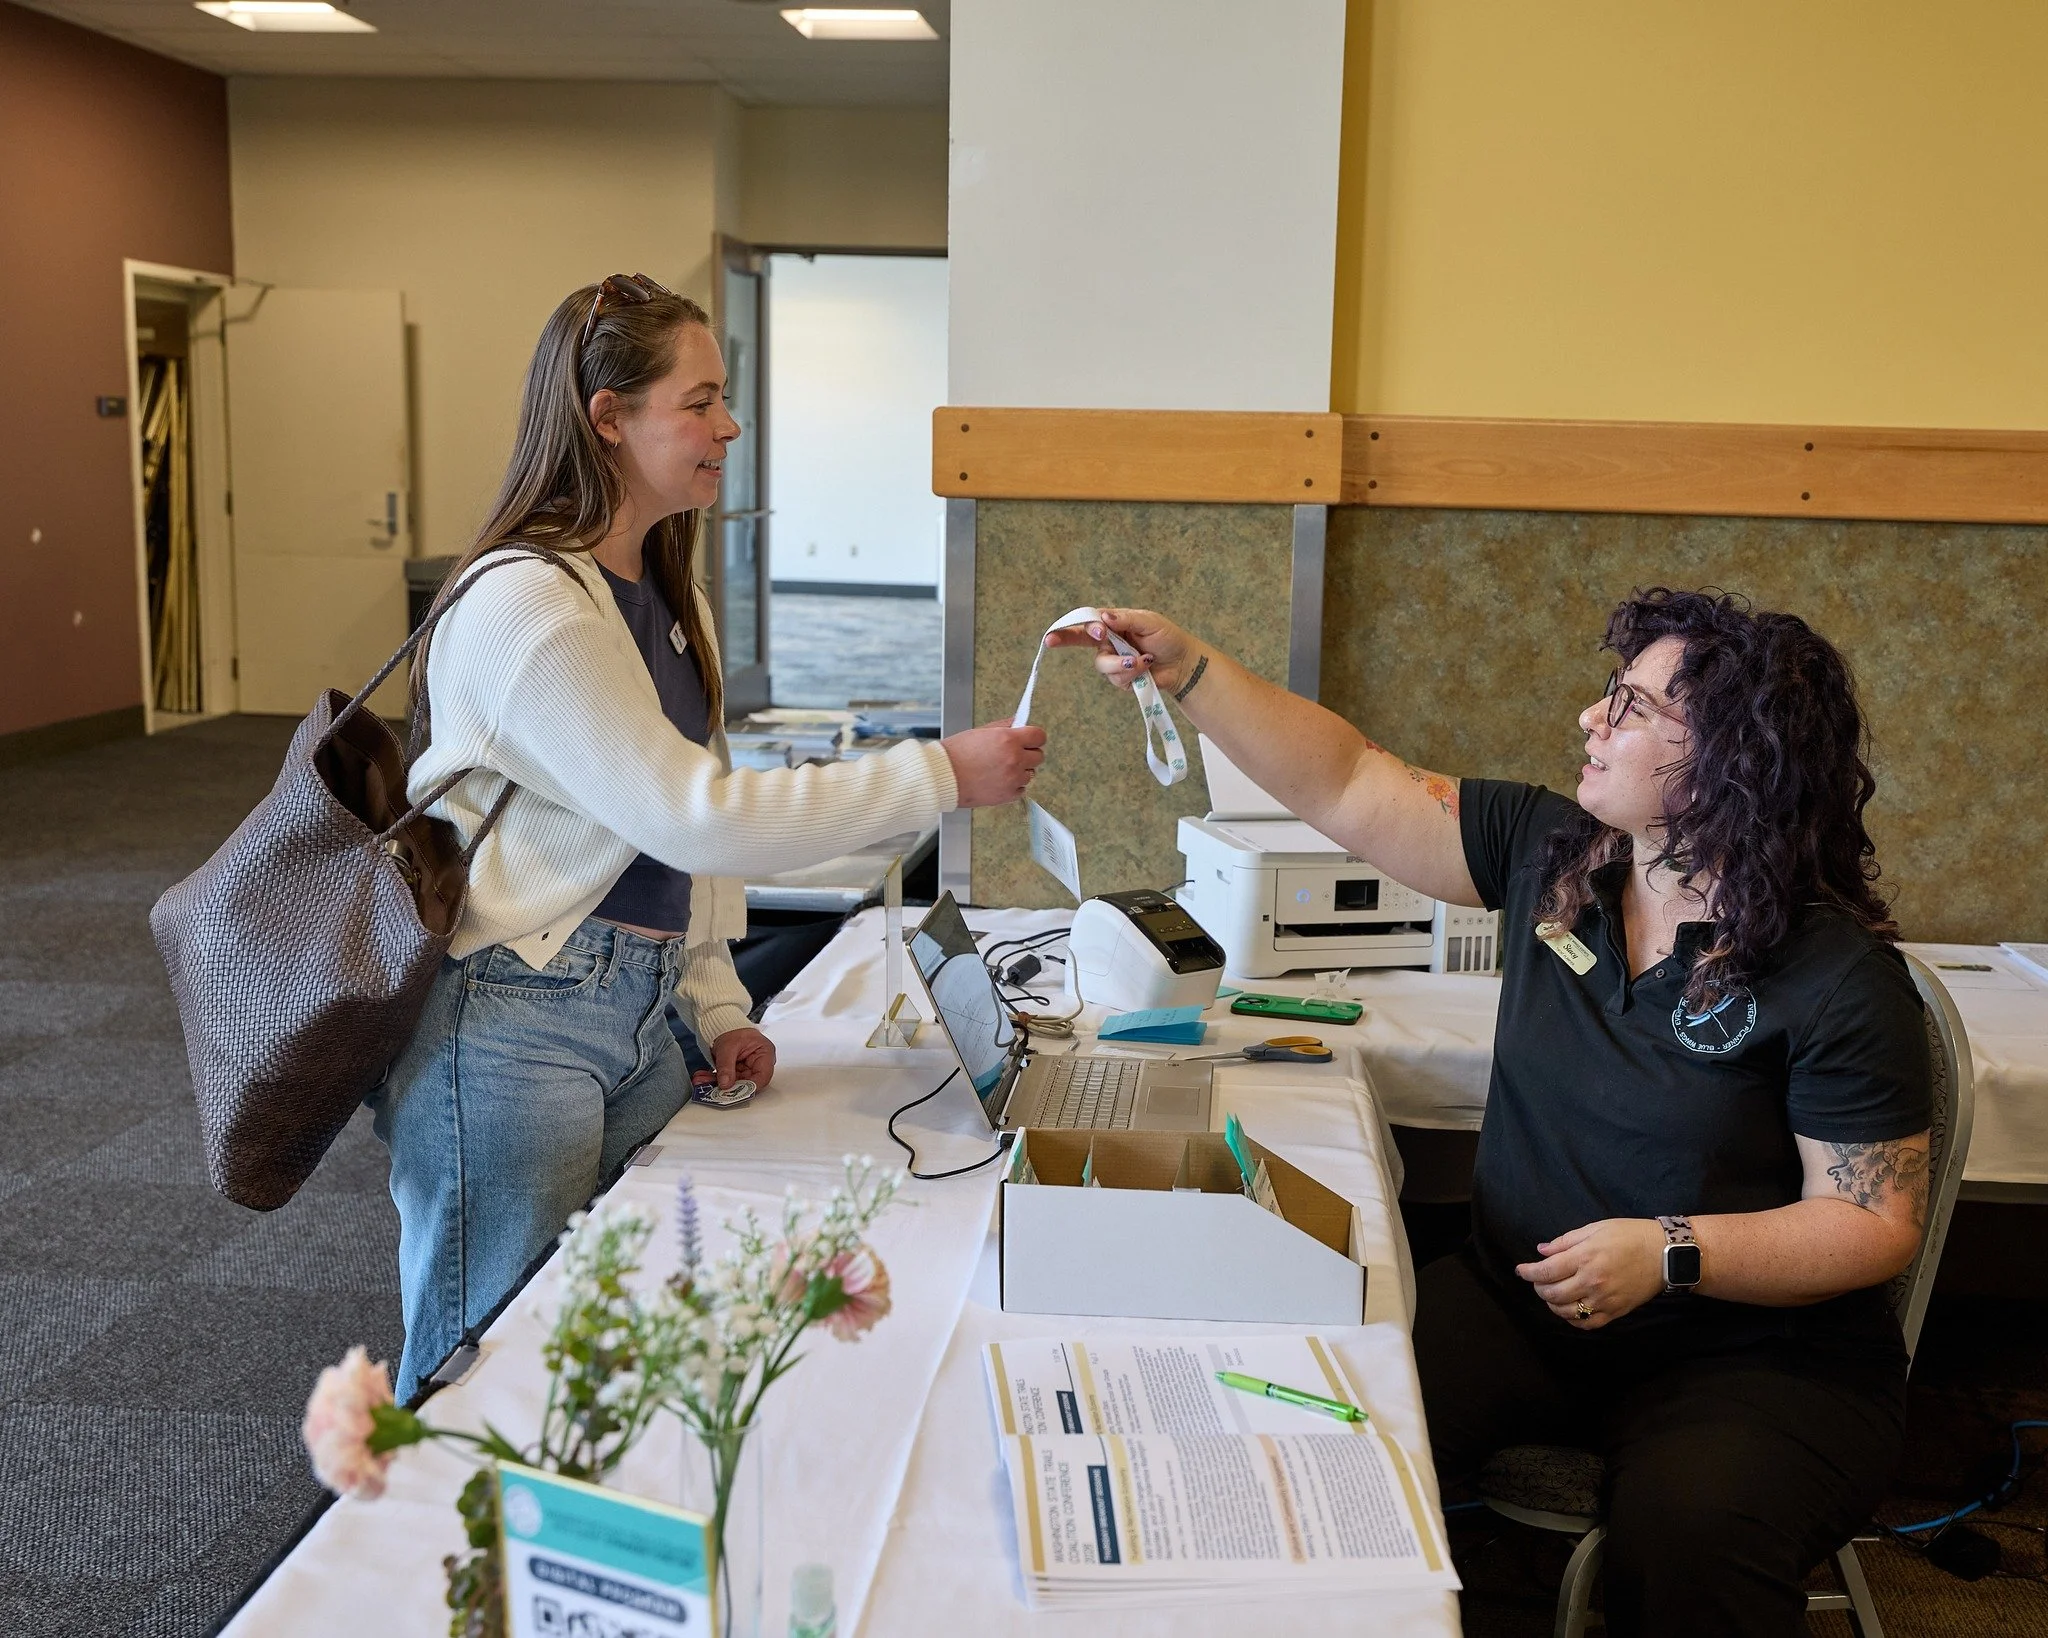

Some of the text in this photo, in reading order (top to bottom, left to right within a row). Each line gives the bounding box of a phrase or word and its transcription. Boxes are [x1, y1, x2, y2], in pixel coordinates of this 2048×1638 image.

[1346, 855, 1368, 864] EPSO
[1563, 943, 1579, 960] Stacy
[1746, 1003, 1754, 1024] EVENT
[1679, 1031, 1696, 1048] WINGS
[1698, 1043, 1715, 1051] BLUE
[1722, 1025, 1750, 1050] PLANNER
[1045, 1475, 1058, 1502] STATE
[1058, 1461, 1080, 1564] COALITION CONFERENCE
[1049, 1506, 1064, 1563] WASHINGTON
